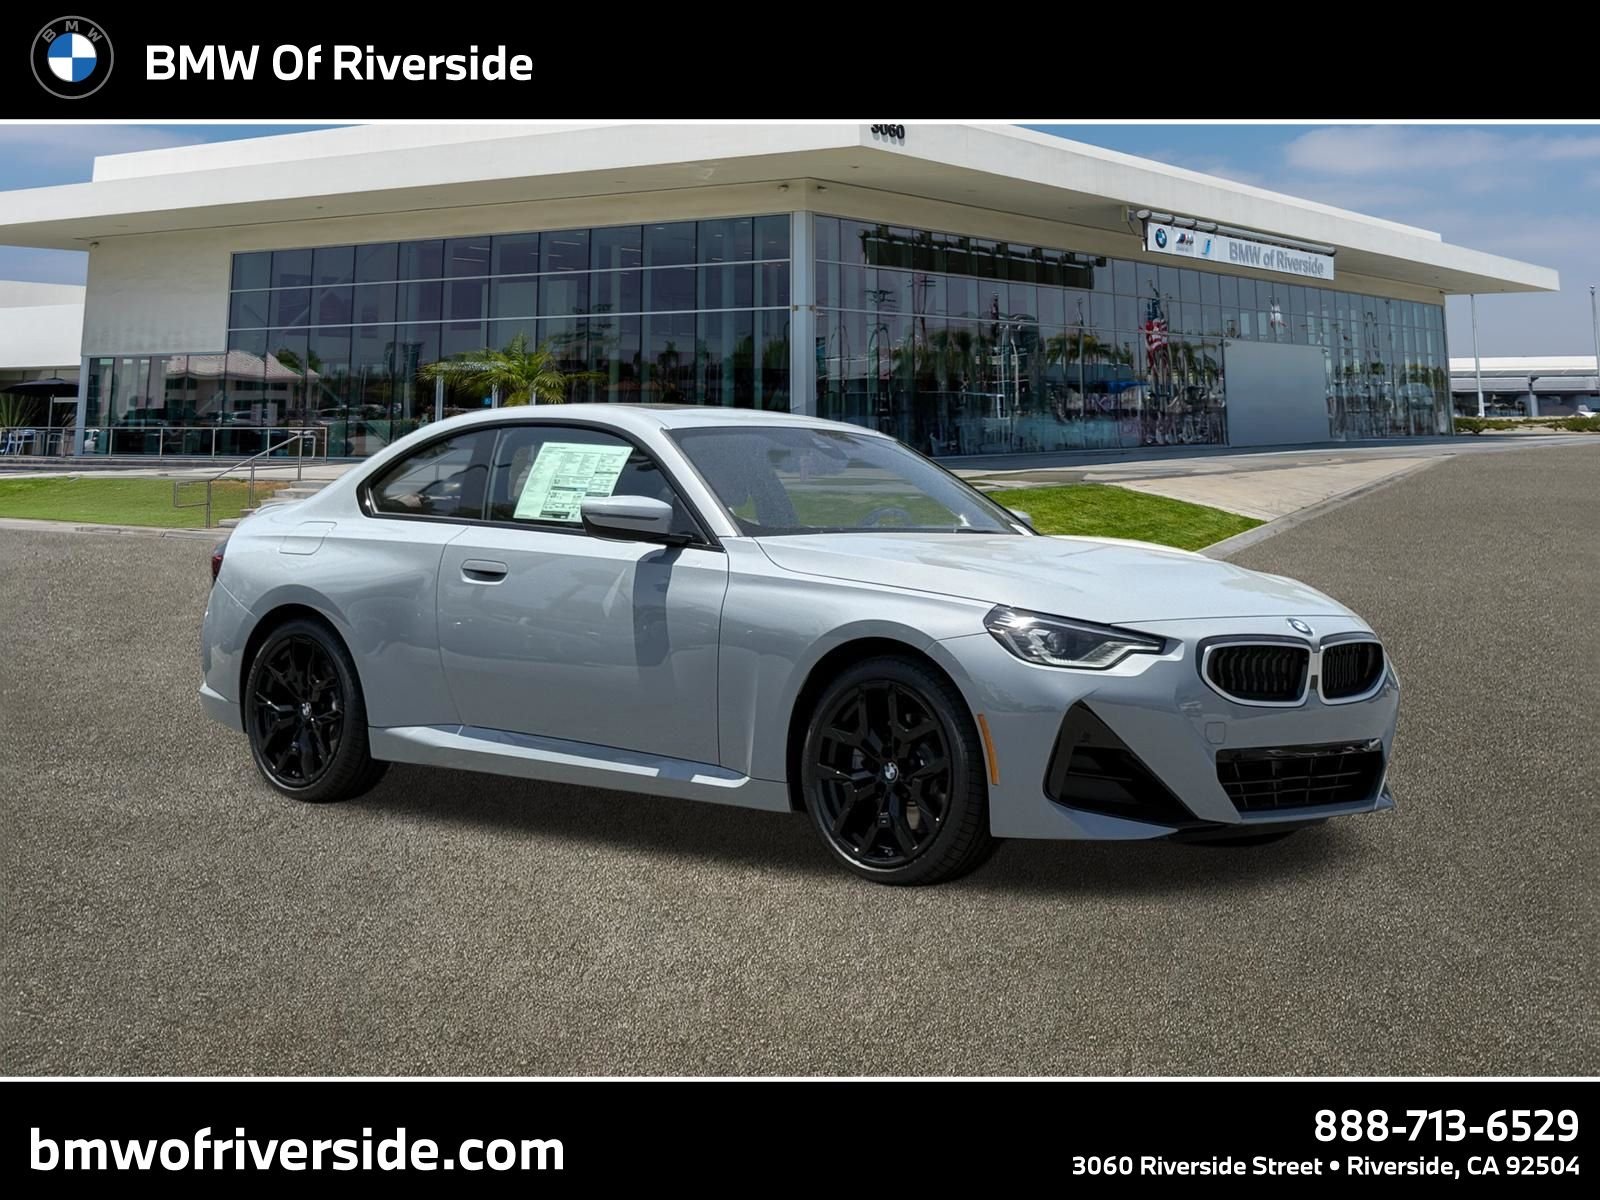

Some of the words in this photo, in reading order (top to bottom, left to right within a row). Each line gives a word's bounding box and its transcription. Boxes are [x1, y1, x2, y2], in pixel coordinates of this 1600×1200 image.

[1229, 241, 1260, 265] BMW
[1263, 249, 1275, 269] of
[1276, 249, 1324, 275] Riverside
